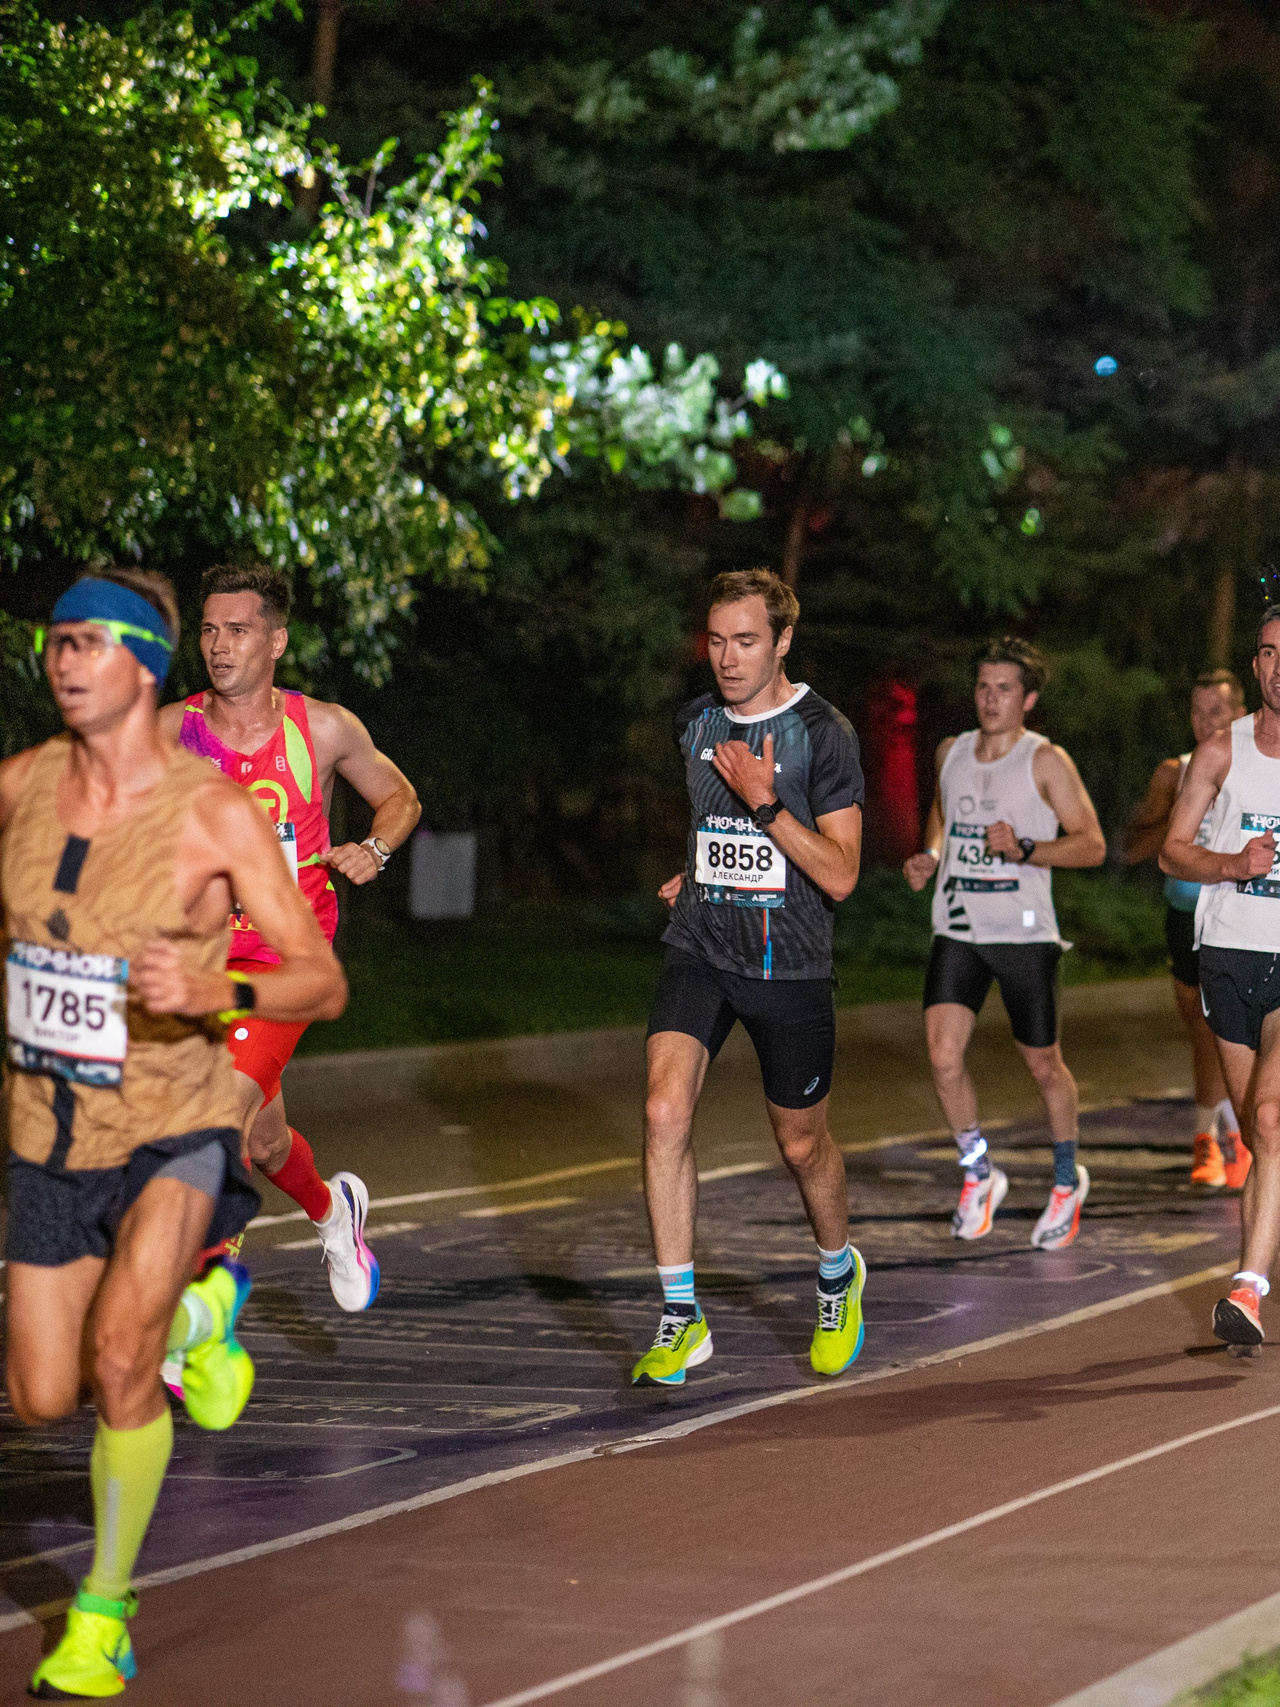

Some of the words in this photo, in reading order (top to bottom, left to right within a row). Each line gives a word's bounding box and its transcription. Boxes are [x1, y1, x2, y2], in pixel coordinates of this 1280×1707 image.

[708, 841, 773, 872] 8858
[713, 871, 764, 883] АЛЕКСАНДР
[22, 979, 106, 1031] 1785
